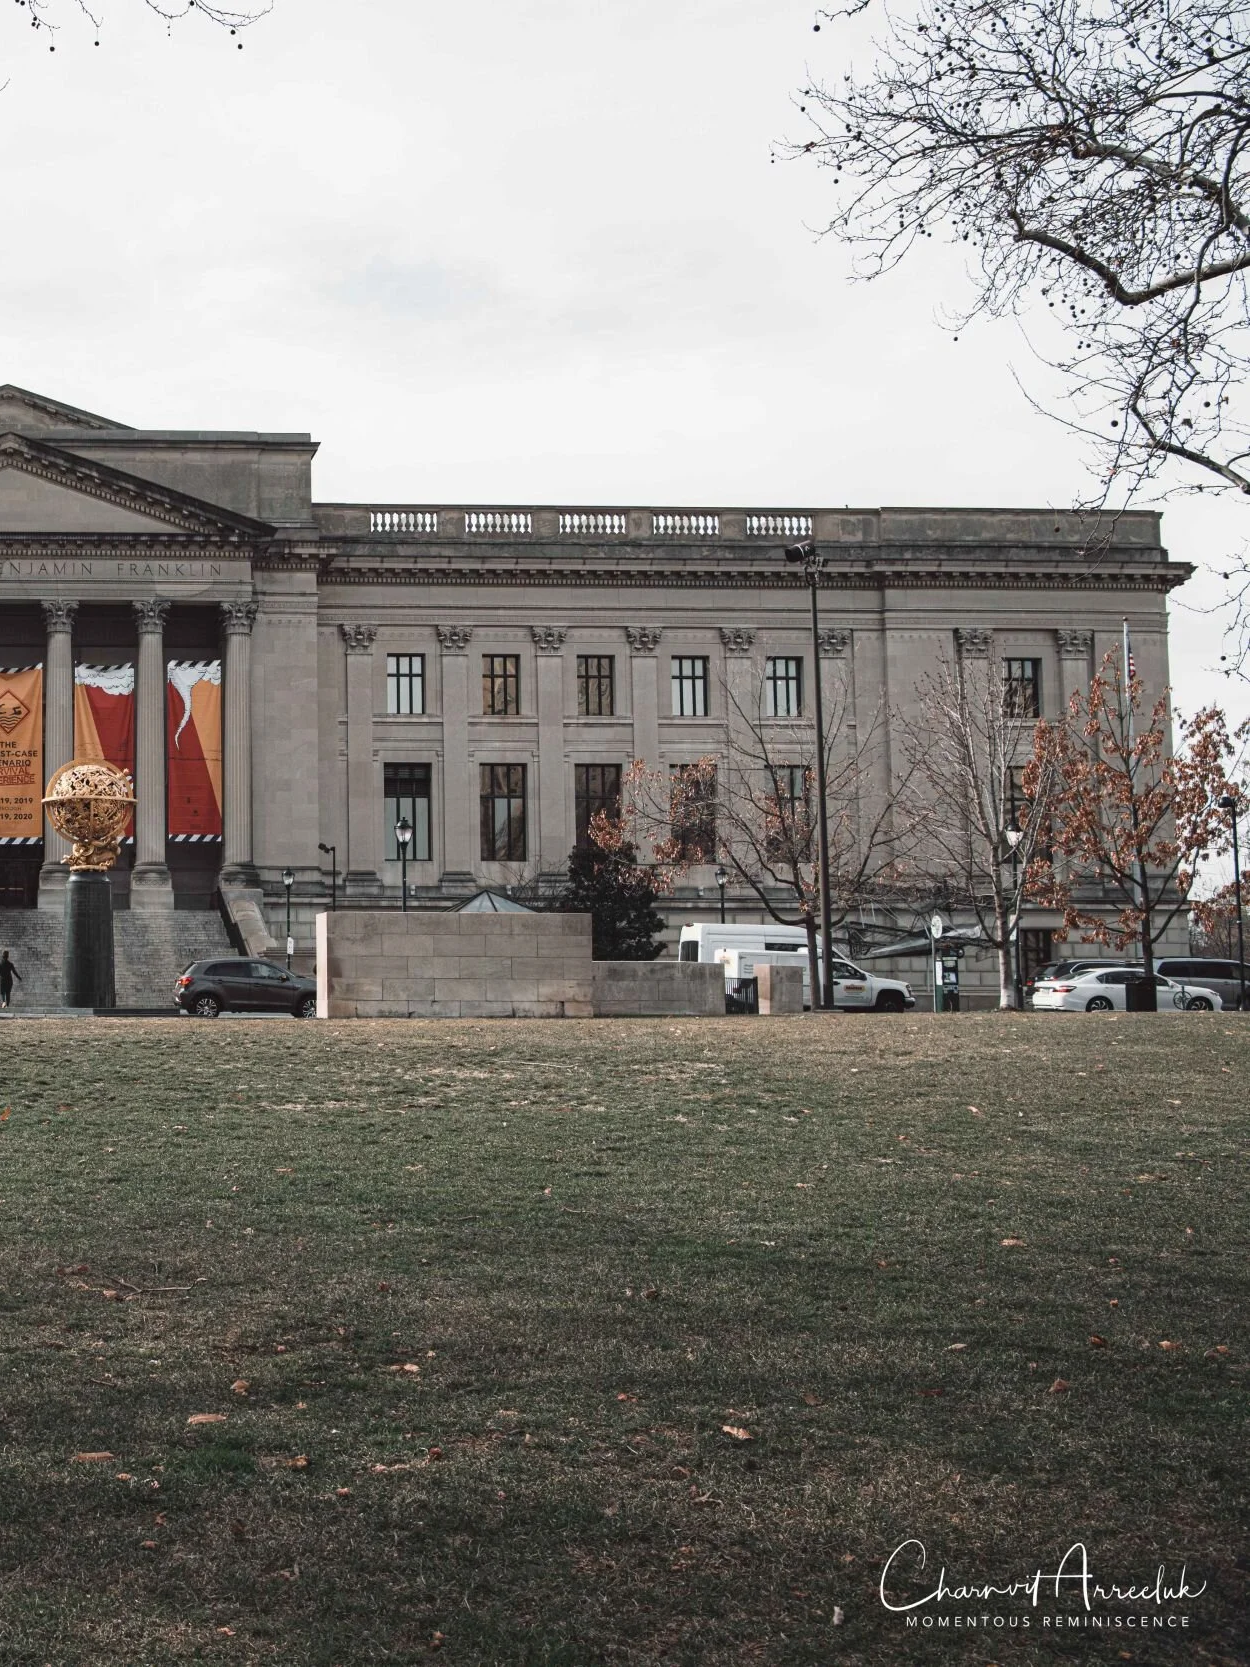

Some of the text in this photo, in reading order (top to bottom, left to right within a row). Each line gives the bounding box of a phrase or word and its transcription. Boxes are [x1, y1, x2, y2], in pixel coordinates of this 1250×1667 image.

[117, 562, 222, 577] FRANKLIN
[0, 741, 17, 749] THE
[0, 797, 12, 805] 19,
[0, 813, 12, 821] 19,
